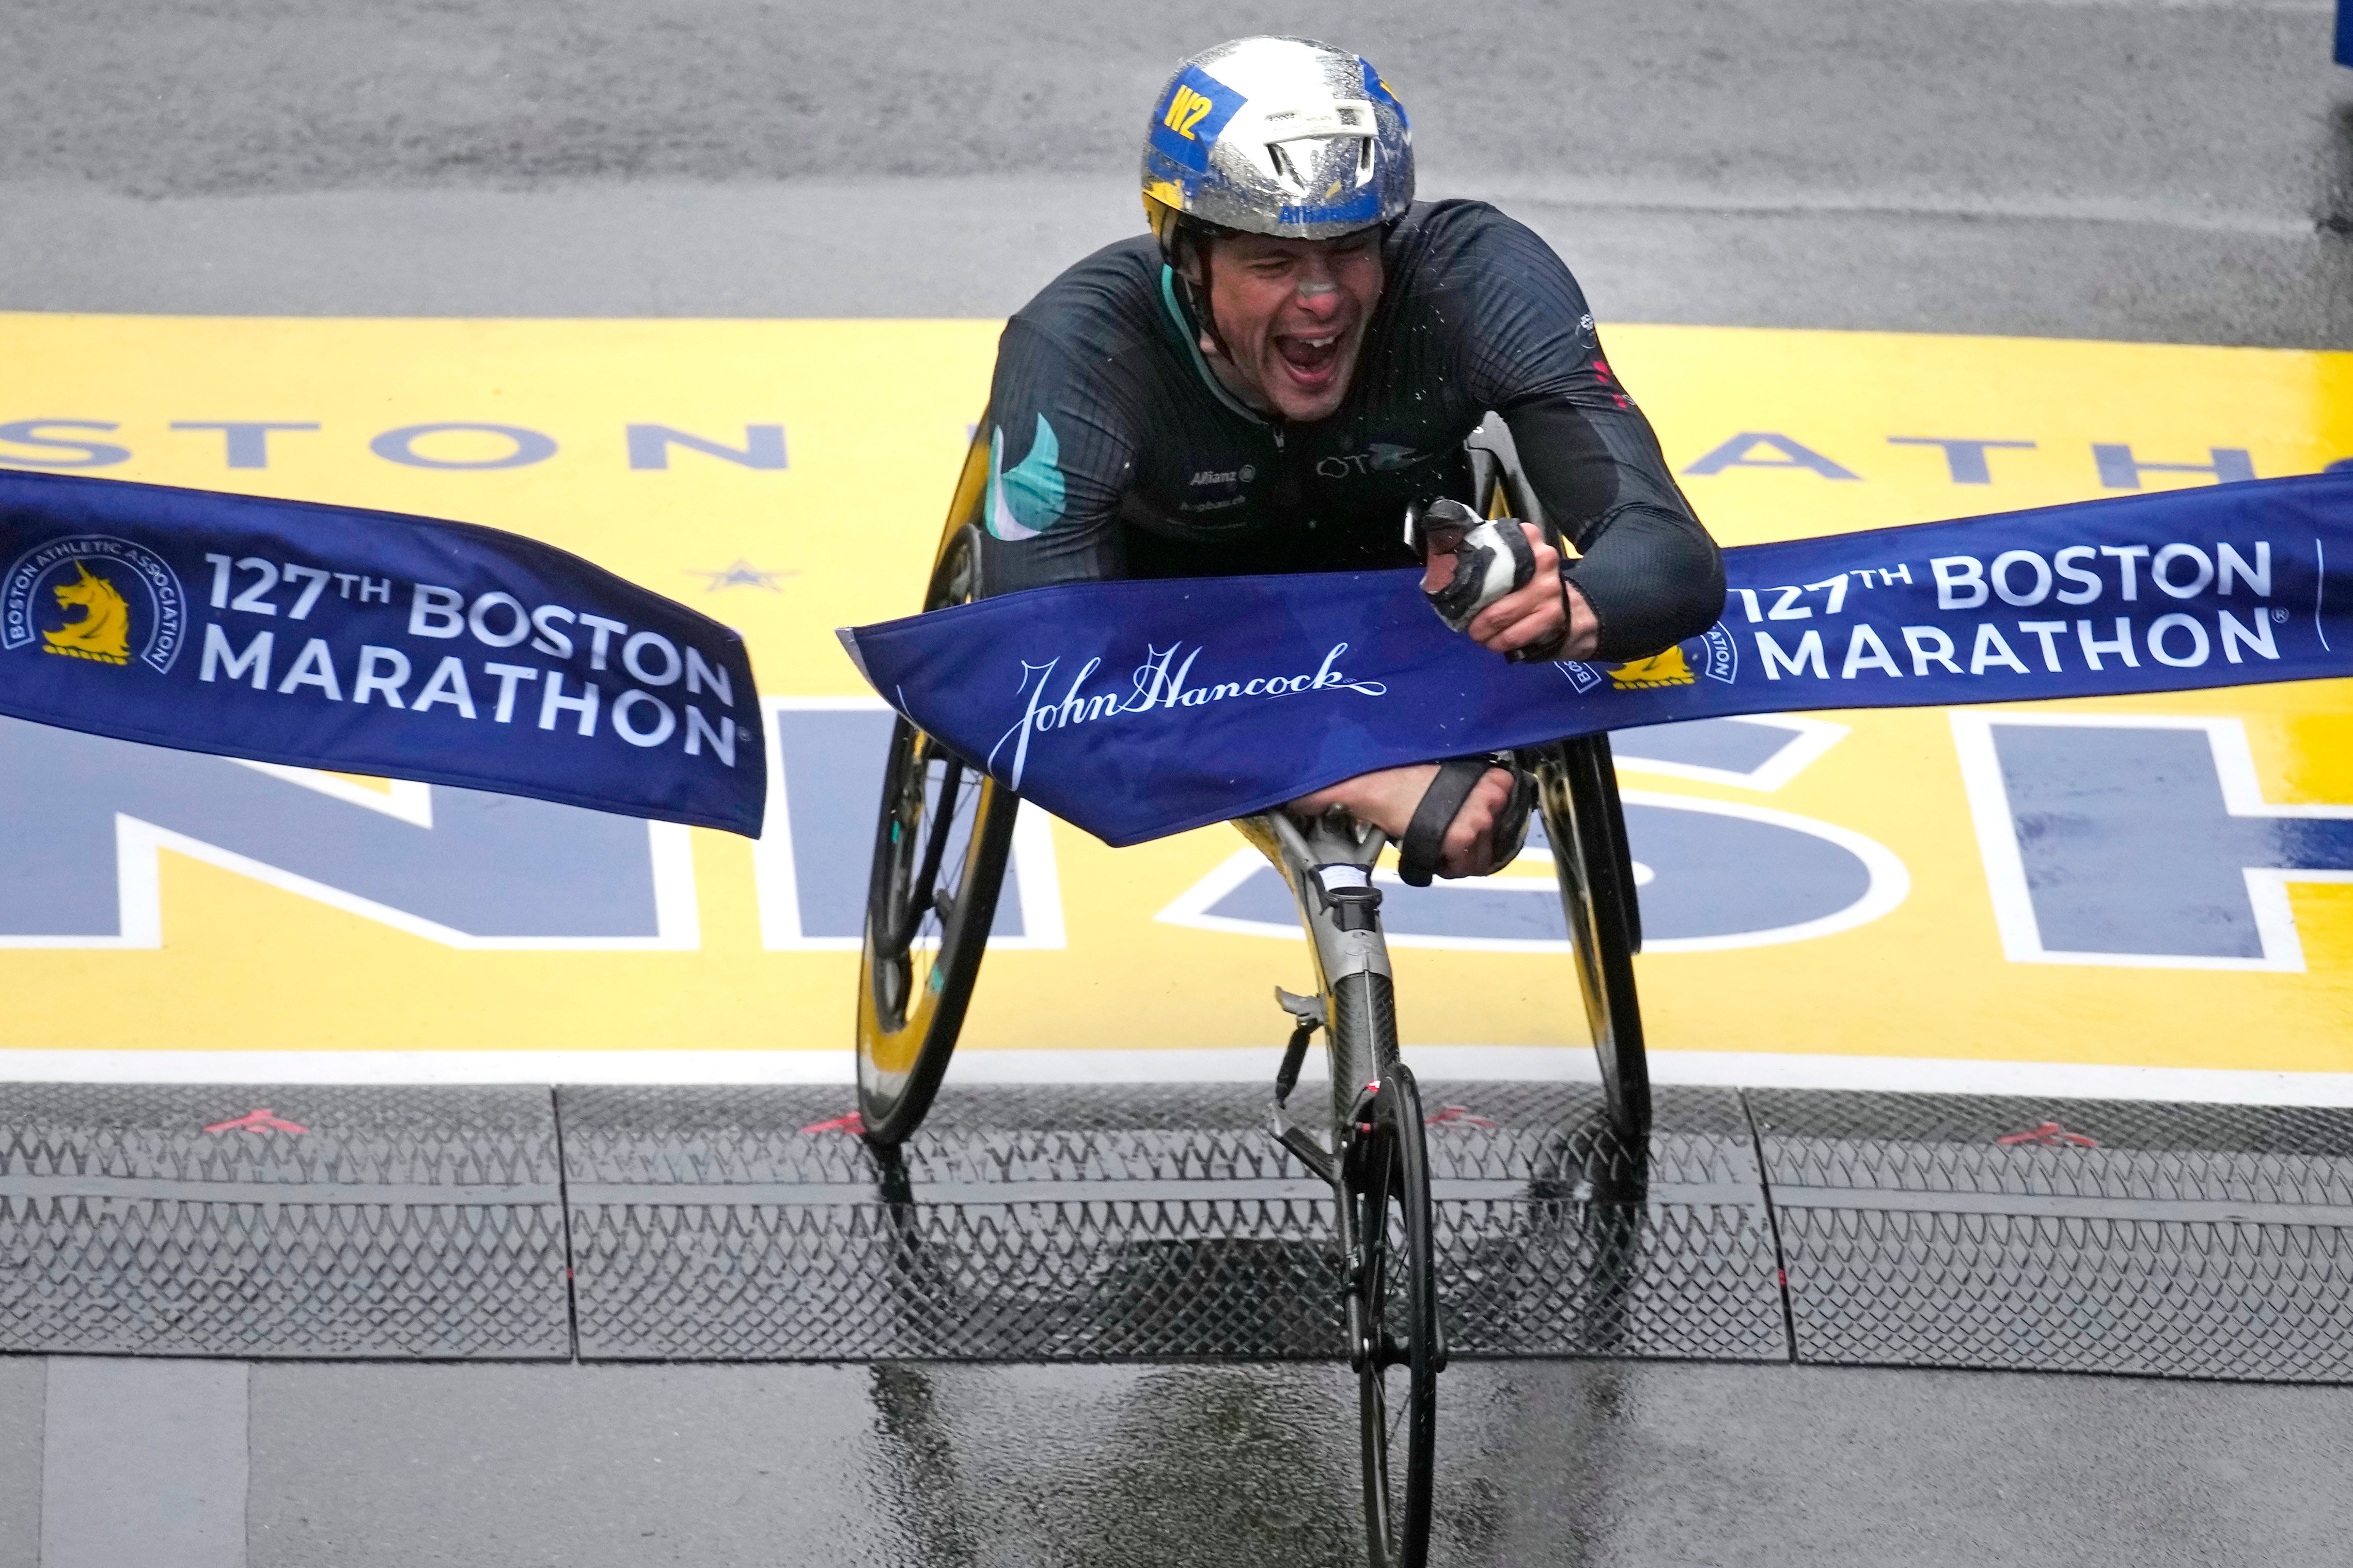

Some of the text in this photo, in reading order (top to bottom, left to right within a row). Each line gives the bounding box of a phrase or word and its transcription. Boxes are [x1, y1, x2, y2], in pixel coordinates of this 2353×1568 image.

[1163, 84, 1213, 140] W2
[1190, 470, 1237, 486] Allianz
[7, 541, 179, 663] BOSTON ATHLETIC ASSOCIATION
[207, 553, 733, 707] 127TH BOSTON
[1726, 541, 2271, 623] 127TH BOSTON
[987, 641, 1387, 791] John Hancock
